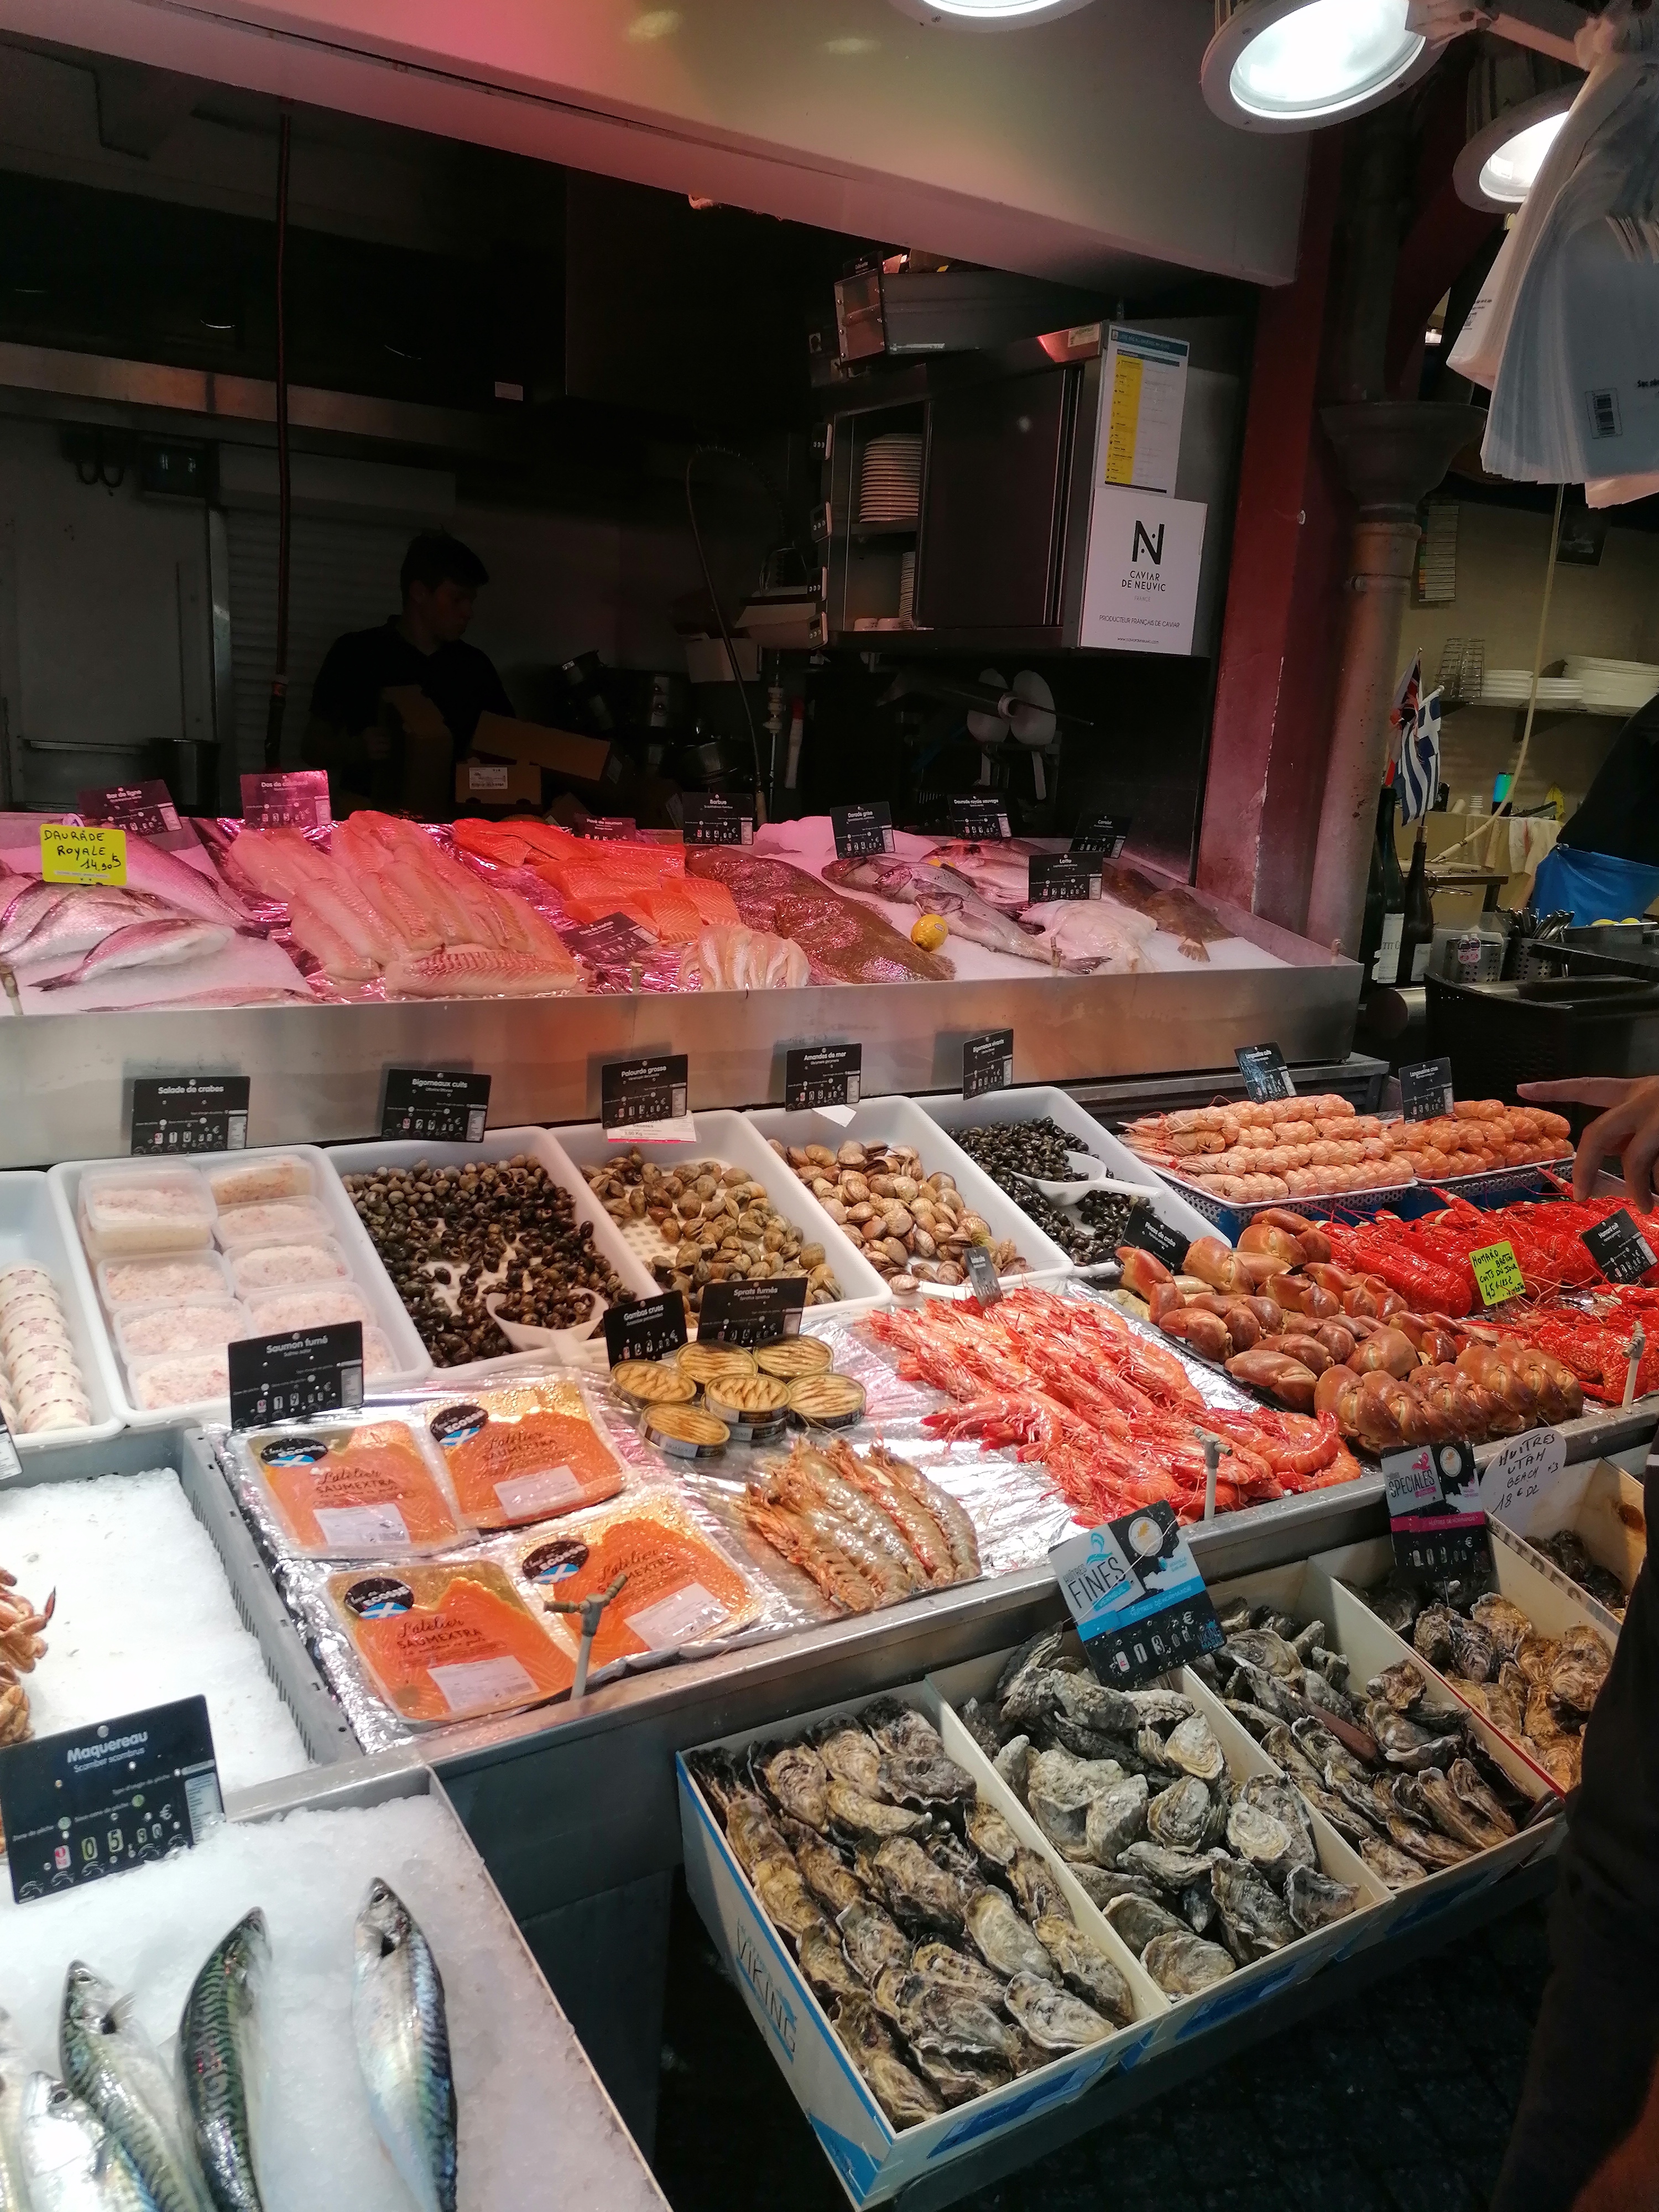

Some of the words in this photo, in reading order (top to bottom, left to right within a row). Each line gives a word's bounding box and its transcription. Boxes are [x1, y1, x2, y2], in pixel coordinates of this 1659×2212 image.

[1130, 571, 1160, 581] CAVIAR
[1121, 579, 1131, 588] DE
[1135, 581, 1166, 592] NEUVIC
[1099, 614, 1130, 624] PRODUCTEUR
[1131, 618, 1154, 627] FRANÇAIS
[57, 845, 106, 861] ROYALE
[804, 1053, 828, 1061] Amandes
[621, 1067, 646, 1078] Palourde
[648, 1065, 667, 1074] grosse
[158, 1086, 185, 1094] Salade
[198, 1084, 225, 1093] crabes
[412, 1078, 451, 1087] Bigorneaux
[1472, 1249, 1499, 1267] HOMARD
[733, 1288, 755, 1297] Sprats
[756, 1286, 778, 1295] fumés
[623, 1308, 648, 1321] Gambas
[648, 1305, 664, 1314] crues
[266, 1340, 304, 1354] Saumon
[305, 1334, 328, 1347] fumé
[1499, 1433, 1556, 1467] HUITRES
[1507, 1447, 1546, 1474] UTAH
[1389, 1469, 1436, 1498] SPECIALES
[1506, 1466, 1539, 1489] BEACH
[315, 1478, 398, 1494] SAUMEXTRA
[1491, 1493, 1512, 1515] 18
[1067, 1556, 1127, 1609] FINES
[396, 1627, 483, 1650] SAUMEXTRA
[67, 1730, 148, 1764] Maquereau
